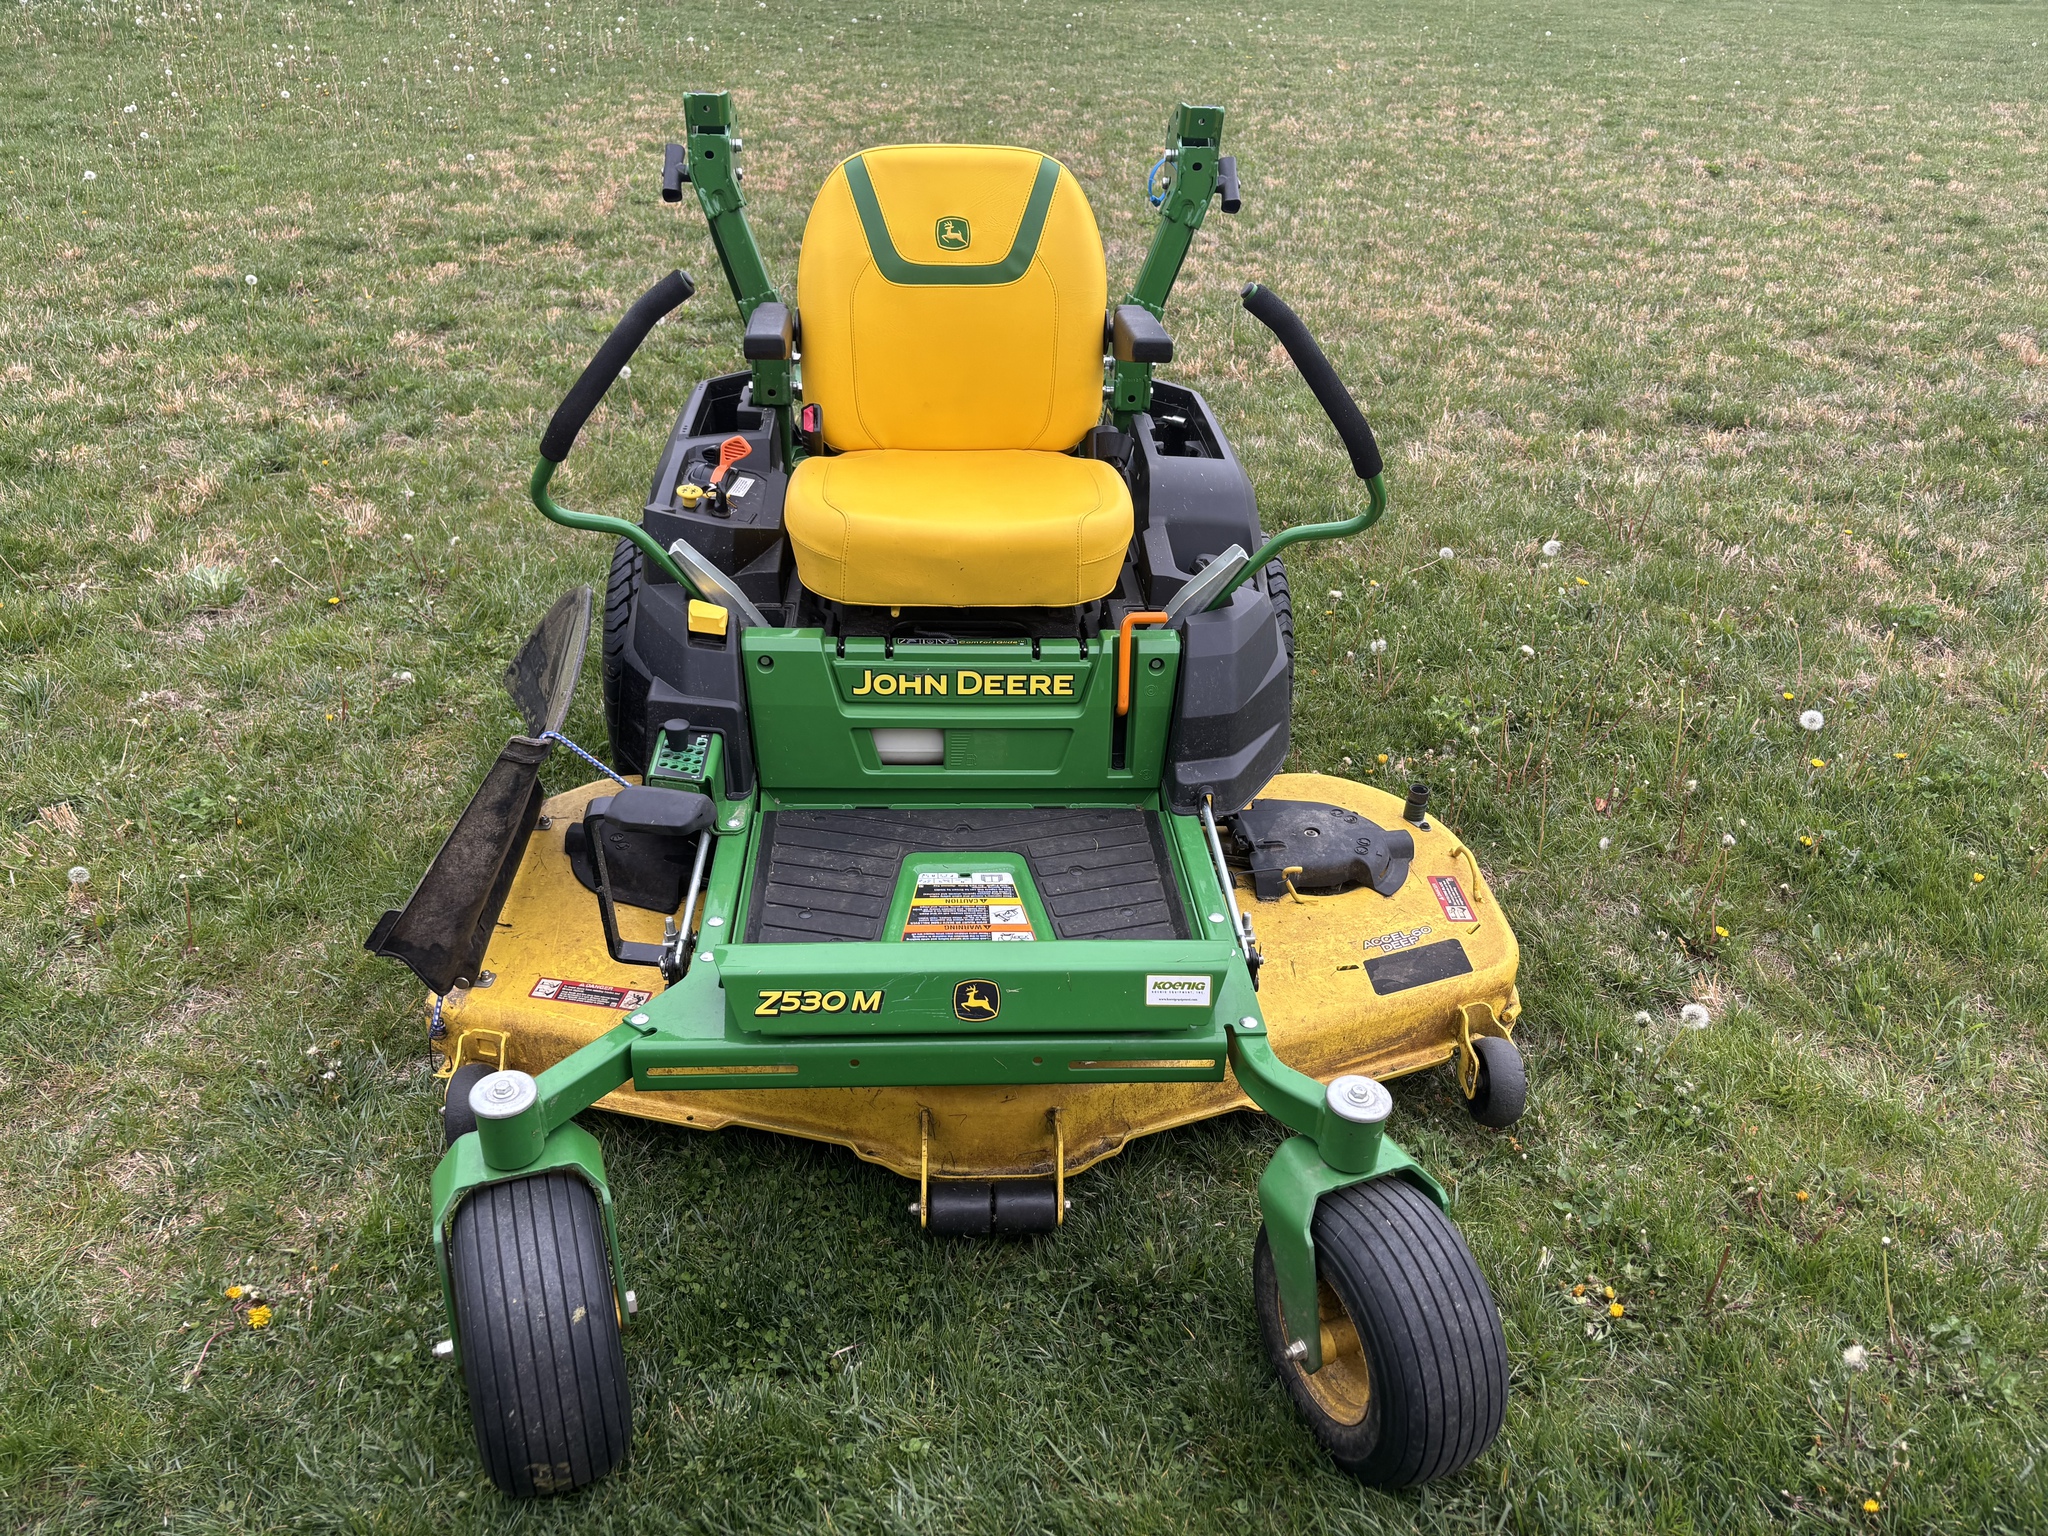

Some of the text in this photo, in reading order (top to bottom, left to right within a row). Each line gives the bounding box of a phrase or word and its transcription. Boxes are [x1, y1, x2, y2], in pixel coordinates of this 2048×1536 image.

[852, 669, 1075, 696] JOHN DEERE
[1363, 926, 1432, 950] ACCEL 60
[1380, 936, 1419, 952] DEEP
[585, 983, 614, 991] DANGER
[754, 990, 883, 1016] Z530 M
